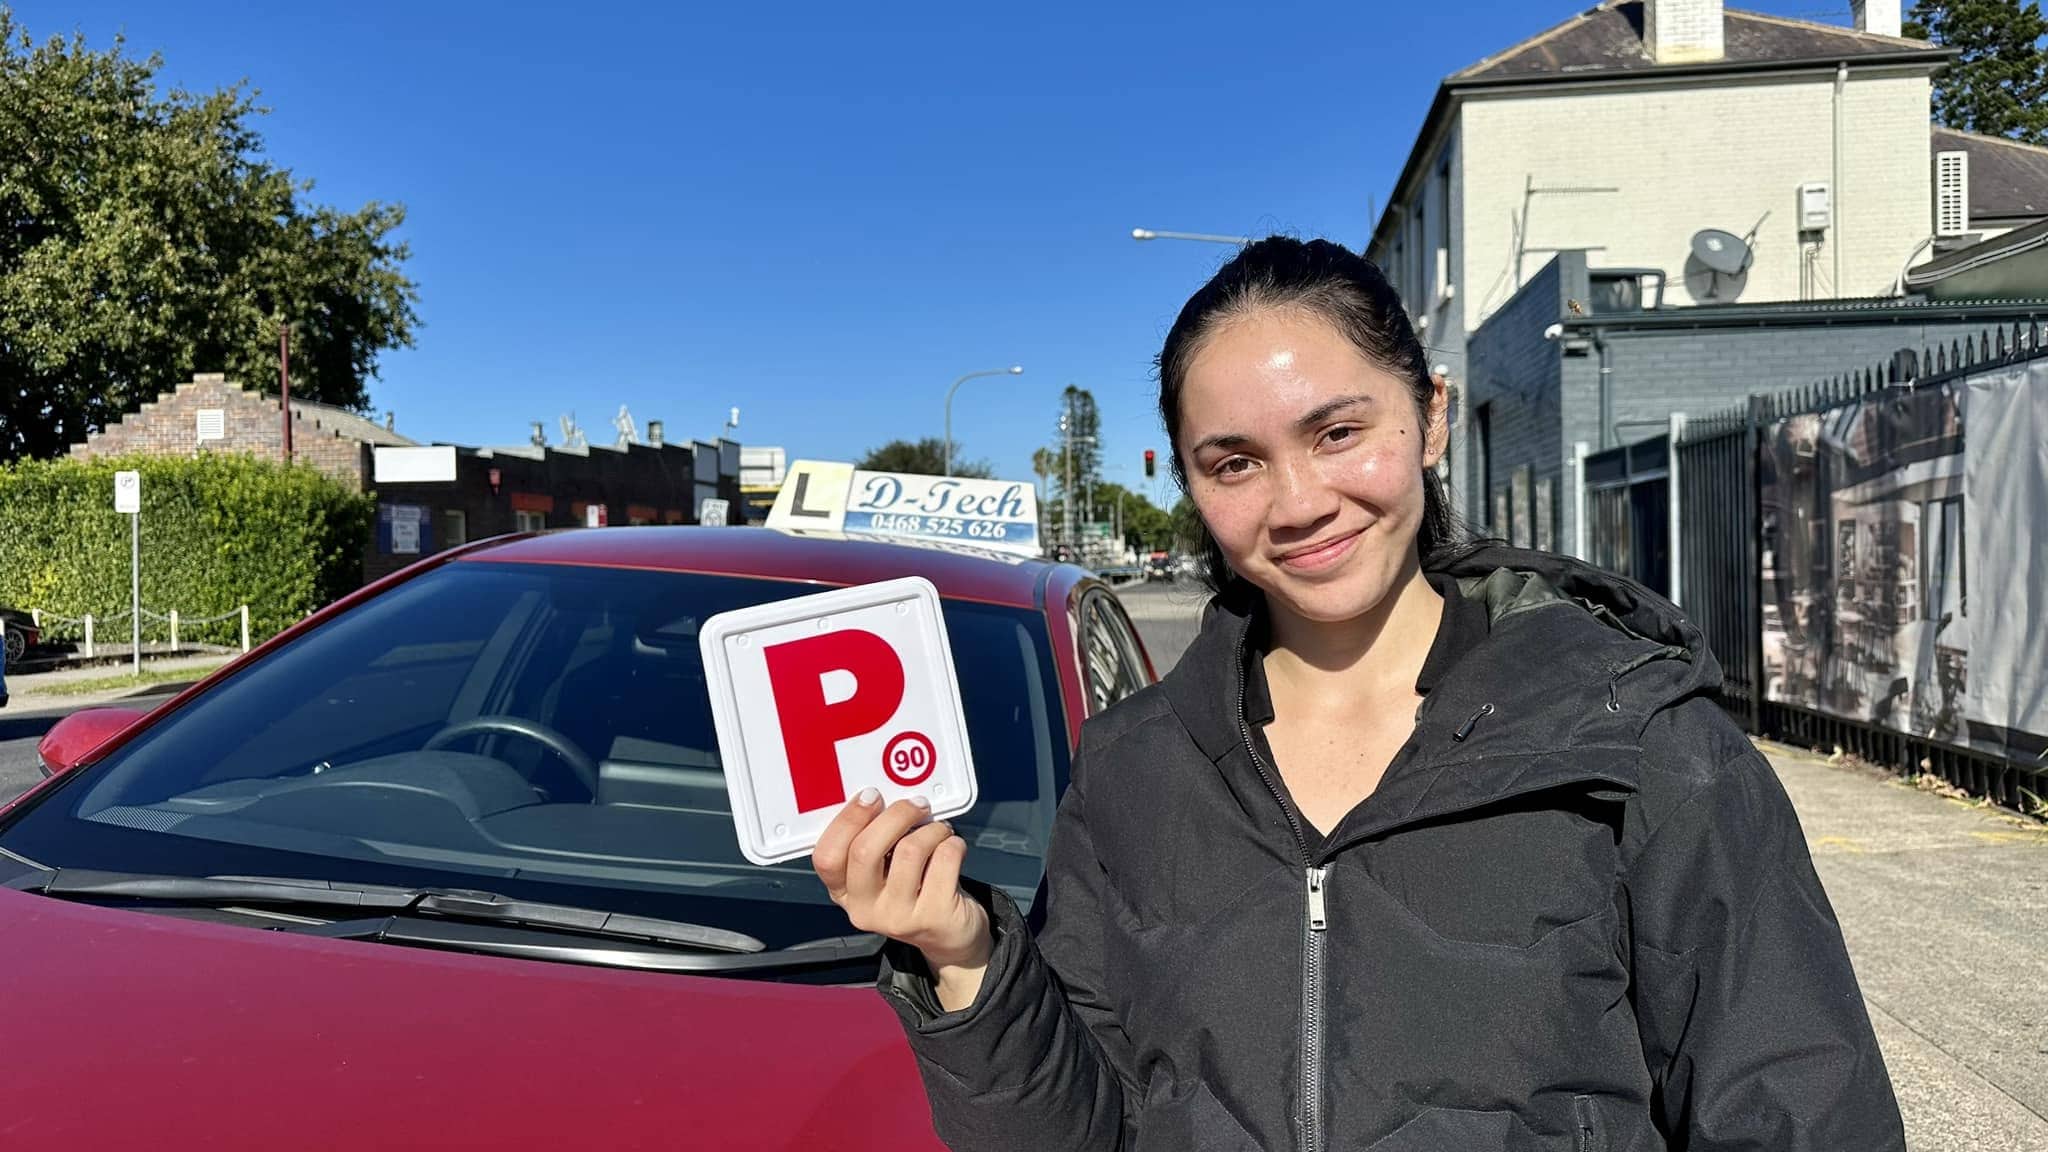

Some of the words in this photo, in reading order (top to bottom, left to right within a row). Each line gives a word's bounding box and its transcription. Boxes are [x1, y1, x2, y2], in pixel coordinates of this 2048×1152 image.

[790, 472, 830, 518] L
[858, 476, 1026, 518] D-Tech
[871, 512, 920, 532] 0468
[925, 517, 964, 536] 525
[968, 521, 1007, 538] 626
[763, 628, 905, 814] P
[894, 746, 925, 771] 90
